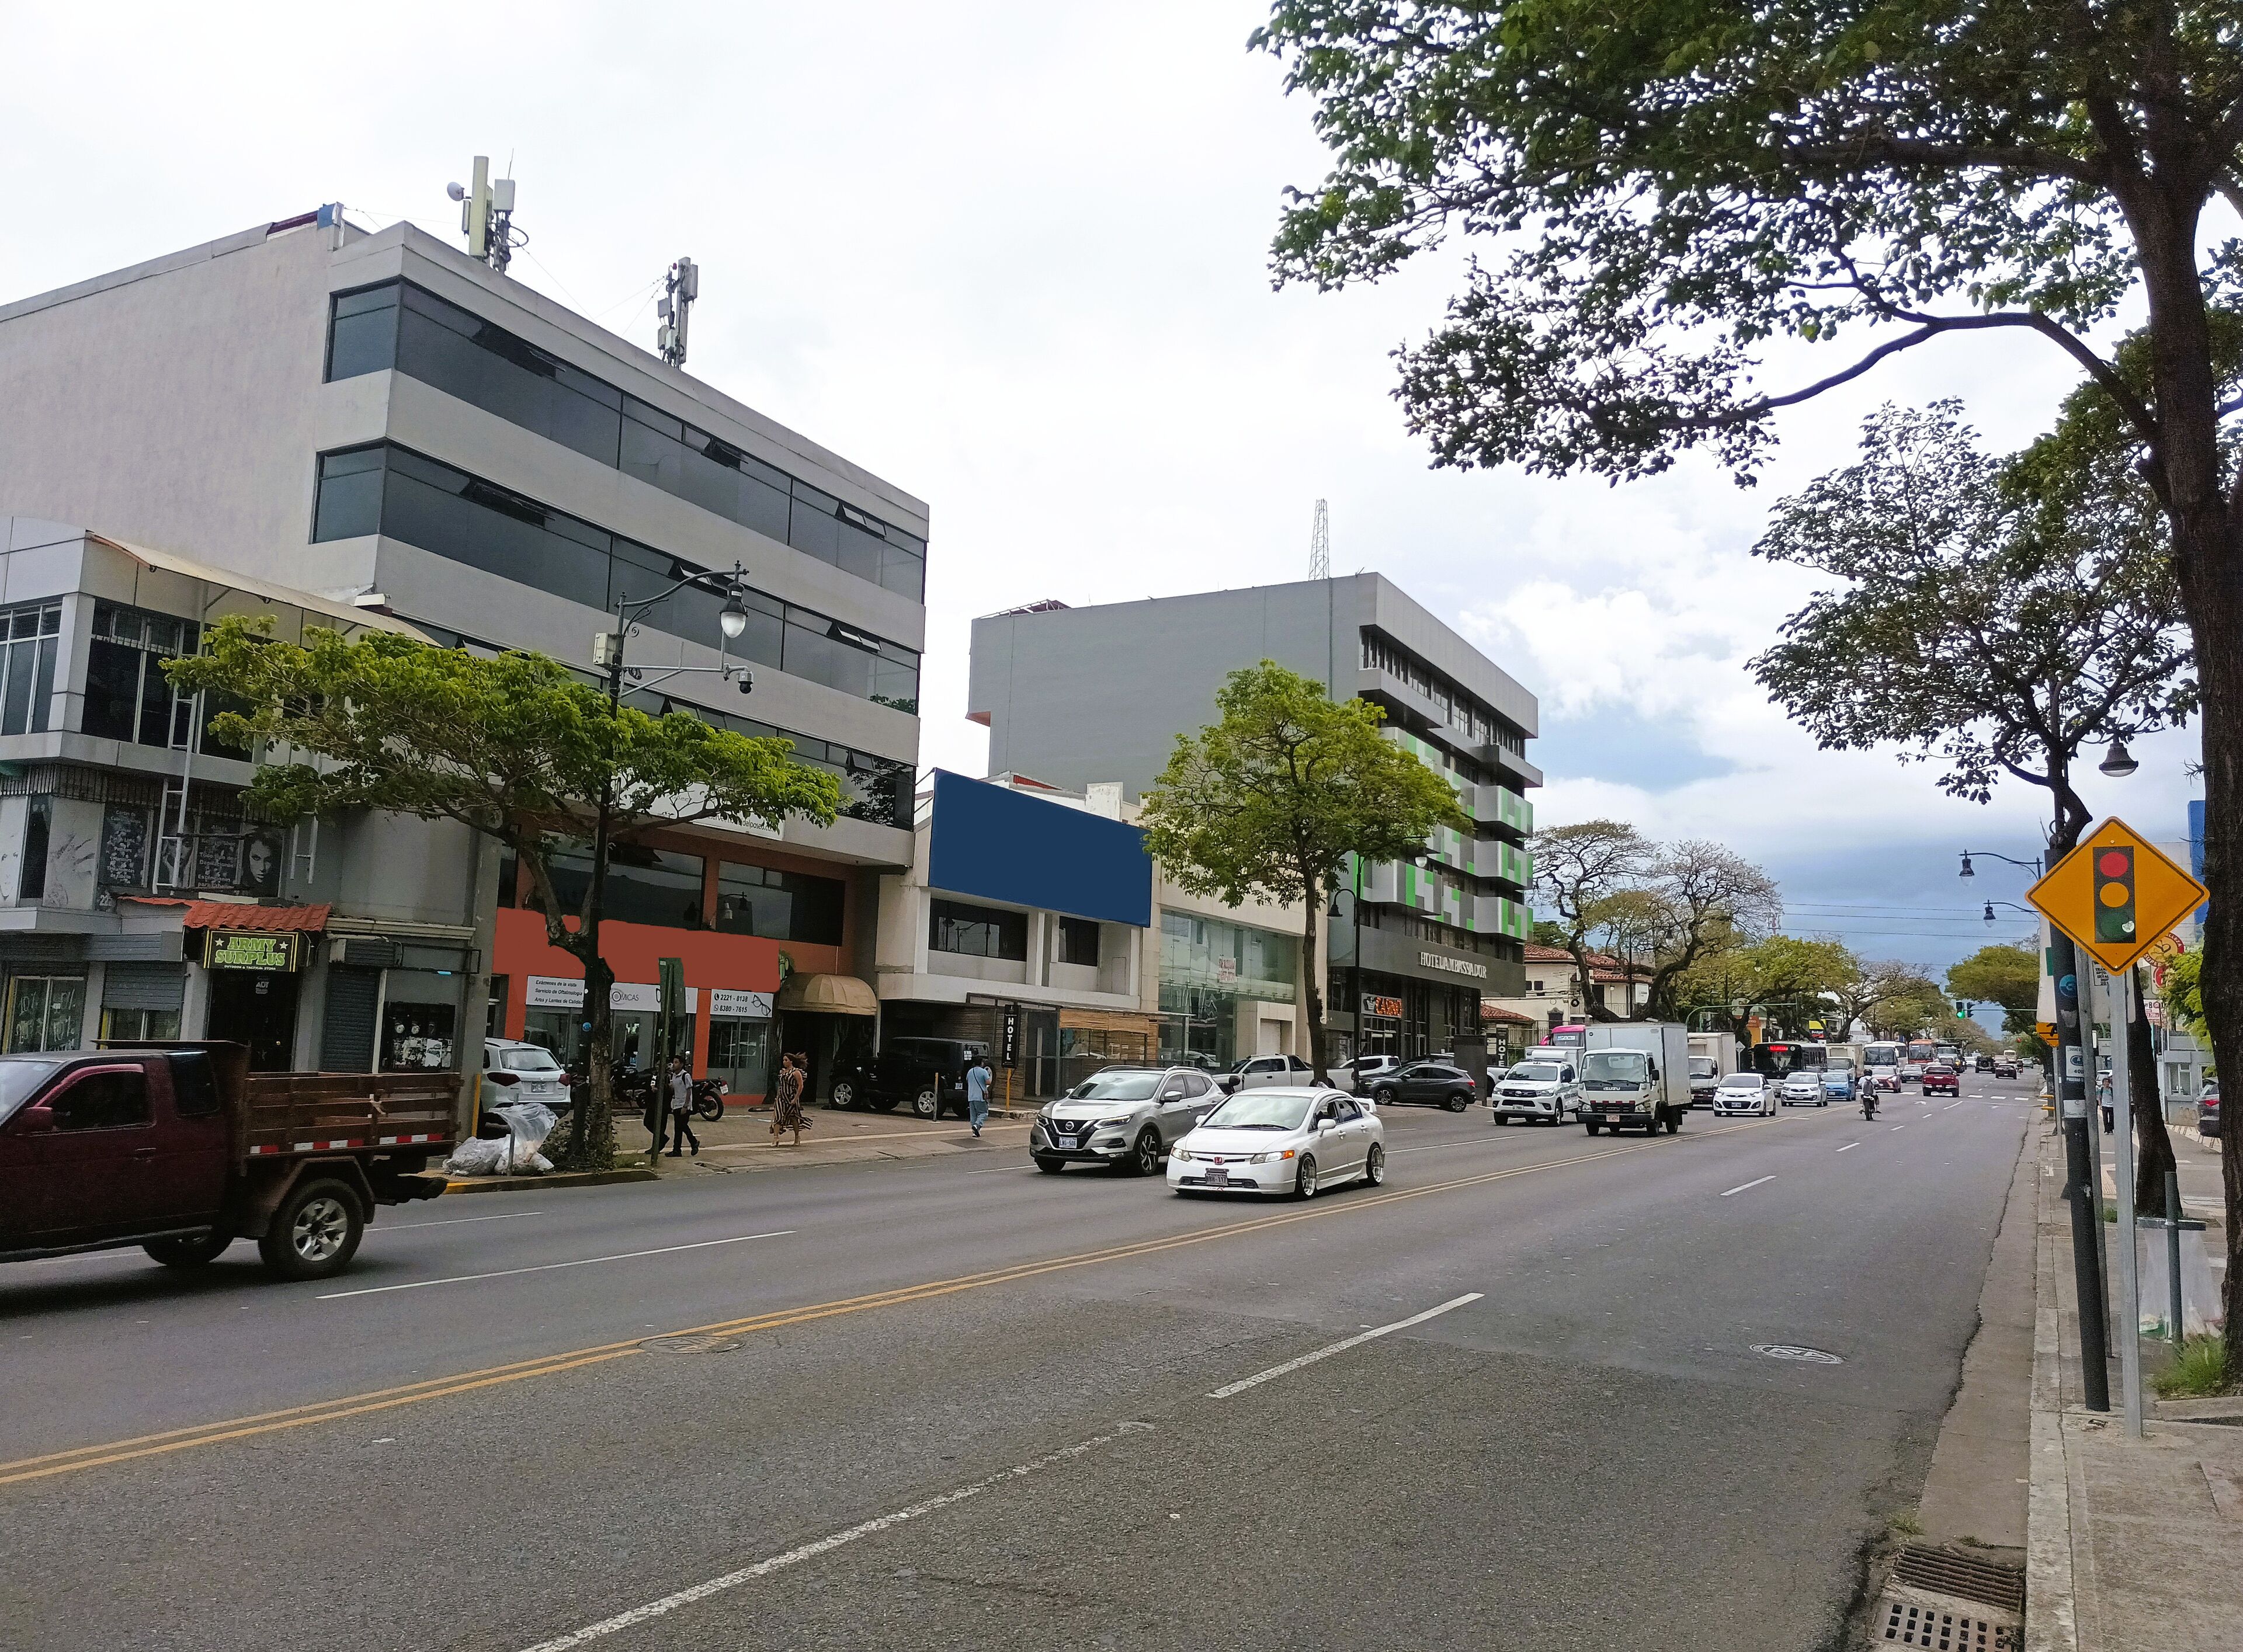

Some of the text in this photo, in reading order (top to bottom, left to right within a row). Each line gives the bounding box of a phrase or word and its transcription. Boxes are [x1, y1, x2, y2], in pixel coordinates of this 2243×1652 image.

[227, 937, 276, 952] ARMY
[215, 950, 286, 966] SURPLUS
[1421, 952, 1487, 979] HOTEL AMBASSADOR
[1498, 1039, 1506, 1067] HOTE
